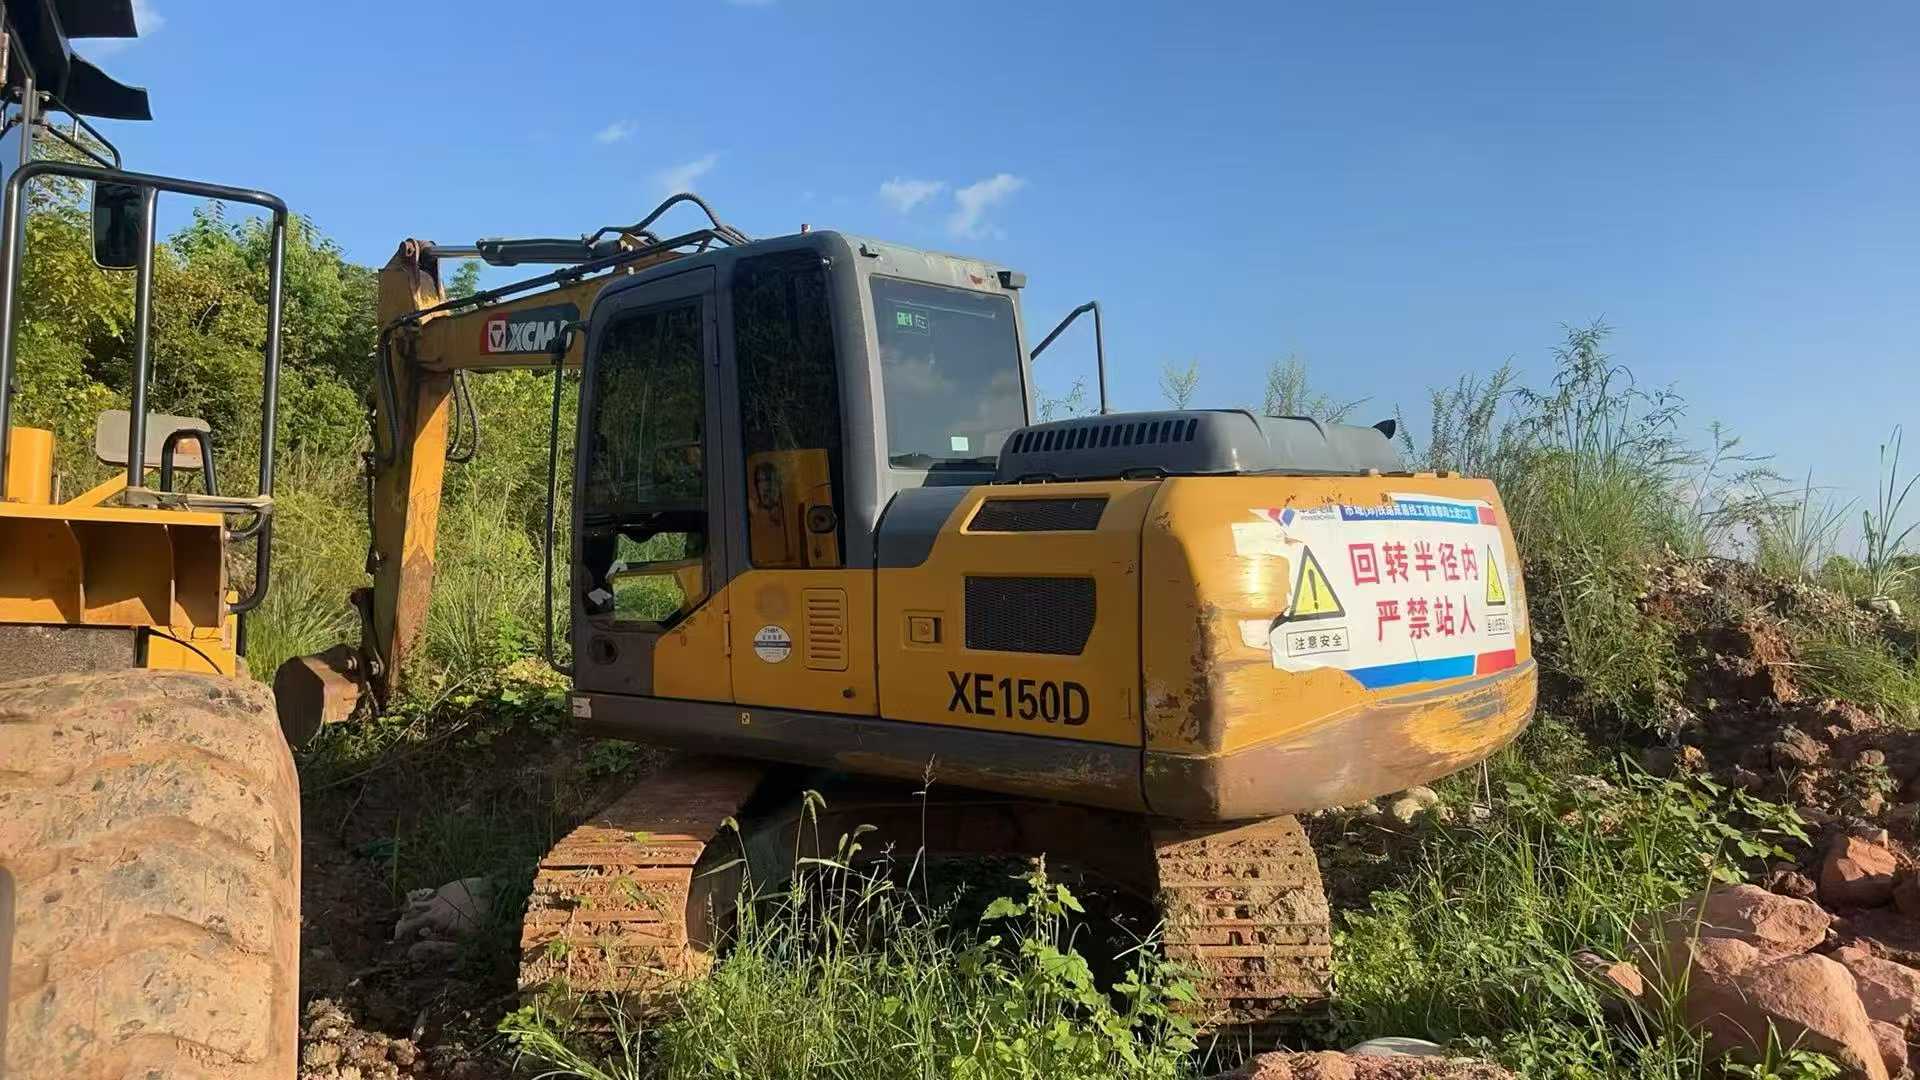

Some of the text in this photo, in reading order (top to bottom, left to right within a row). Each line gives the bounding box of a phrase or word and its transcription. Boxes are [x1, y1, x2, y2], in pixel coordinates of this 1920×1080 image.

[1348, 541, 1479, 586] 回转半径内
[1376, 595, 1476, 642] 严禁站人
[1295, 634, 1342, 650] 注意安全
[947, 671, 1090, 726] XE150D
